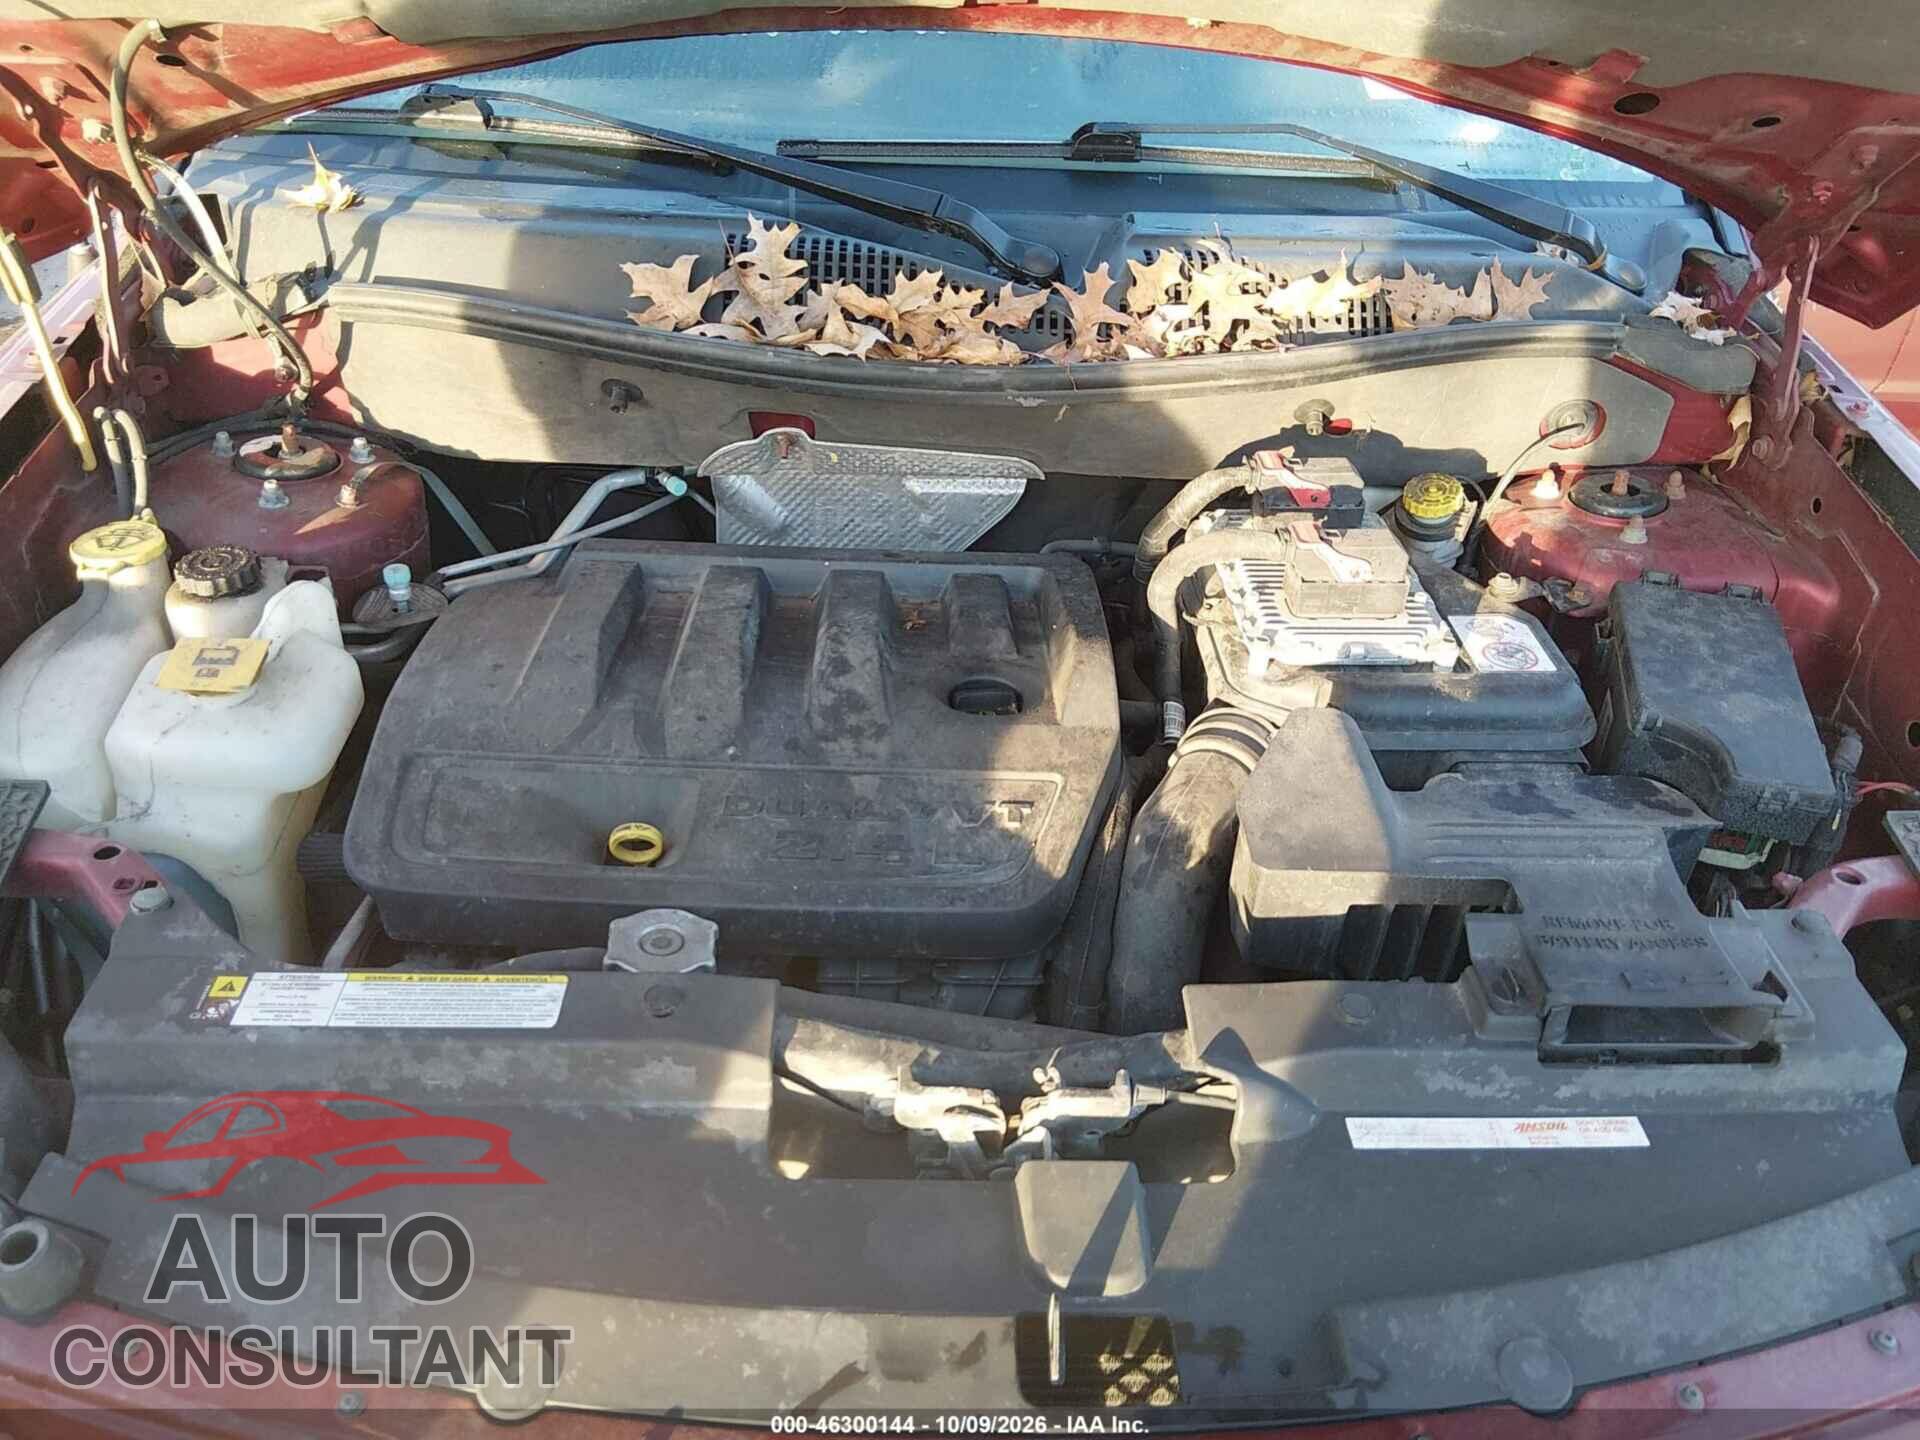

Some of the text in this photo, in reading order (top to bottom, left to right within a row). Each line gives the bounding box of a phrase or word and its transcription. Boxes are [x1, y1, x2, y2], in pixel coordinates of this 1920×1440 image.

[1543, 914, 1676, 932] REMOVE FOR
[1535, 934, 1620, 950] BATTERY
[1513, 1121, 1568, 1132] AMSOIL
